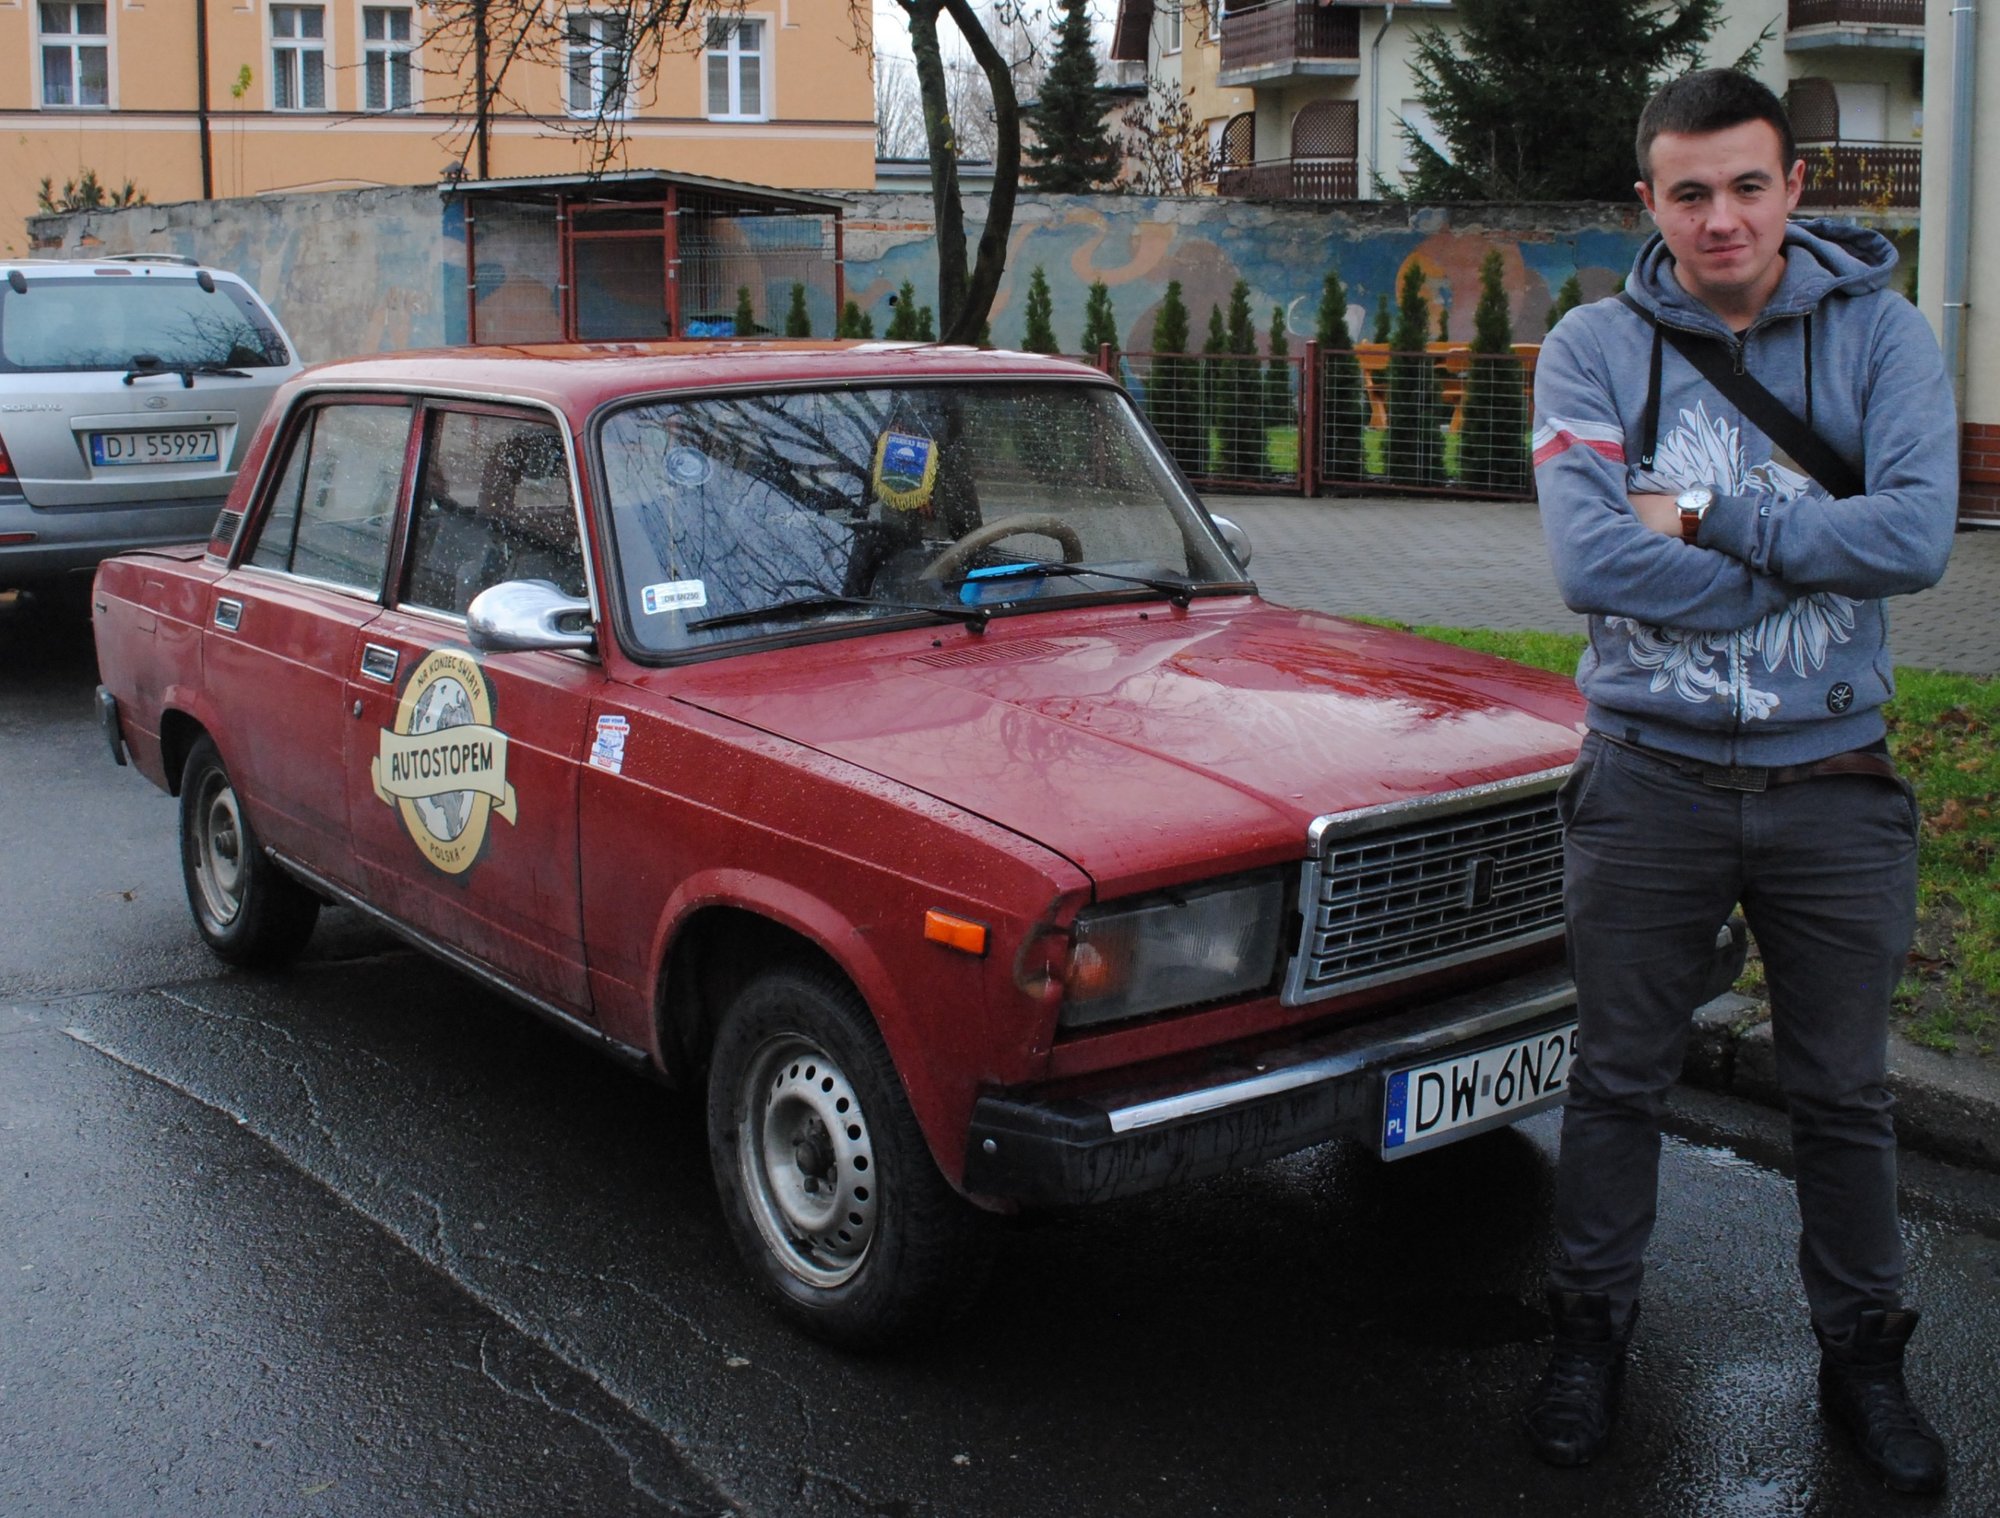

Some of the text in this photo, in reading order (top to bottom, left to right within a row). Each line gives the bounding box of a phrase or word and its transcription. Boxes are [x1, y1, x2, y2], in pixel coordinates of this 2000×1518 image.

[107, 436, 136, 458] DJ
[146, 433, 211, 456] 55997
[417, 656, 481, 700] NA KONIEC ŚWIATA
[391, 742, 493, 782] AUTOSTOPEM
[430, 843, 461, 862] POLSKA
[1387, 1119, 1403, 1136] PL
[1415, 1059, 1480, 1133] DW
